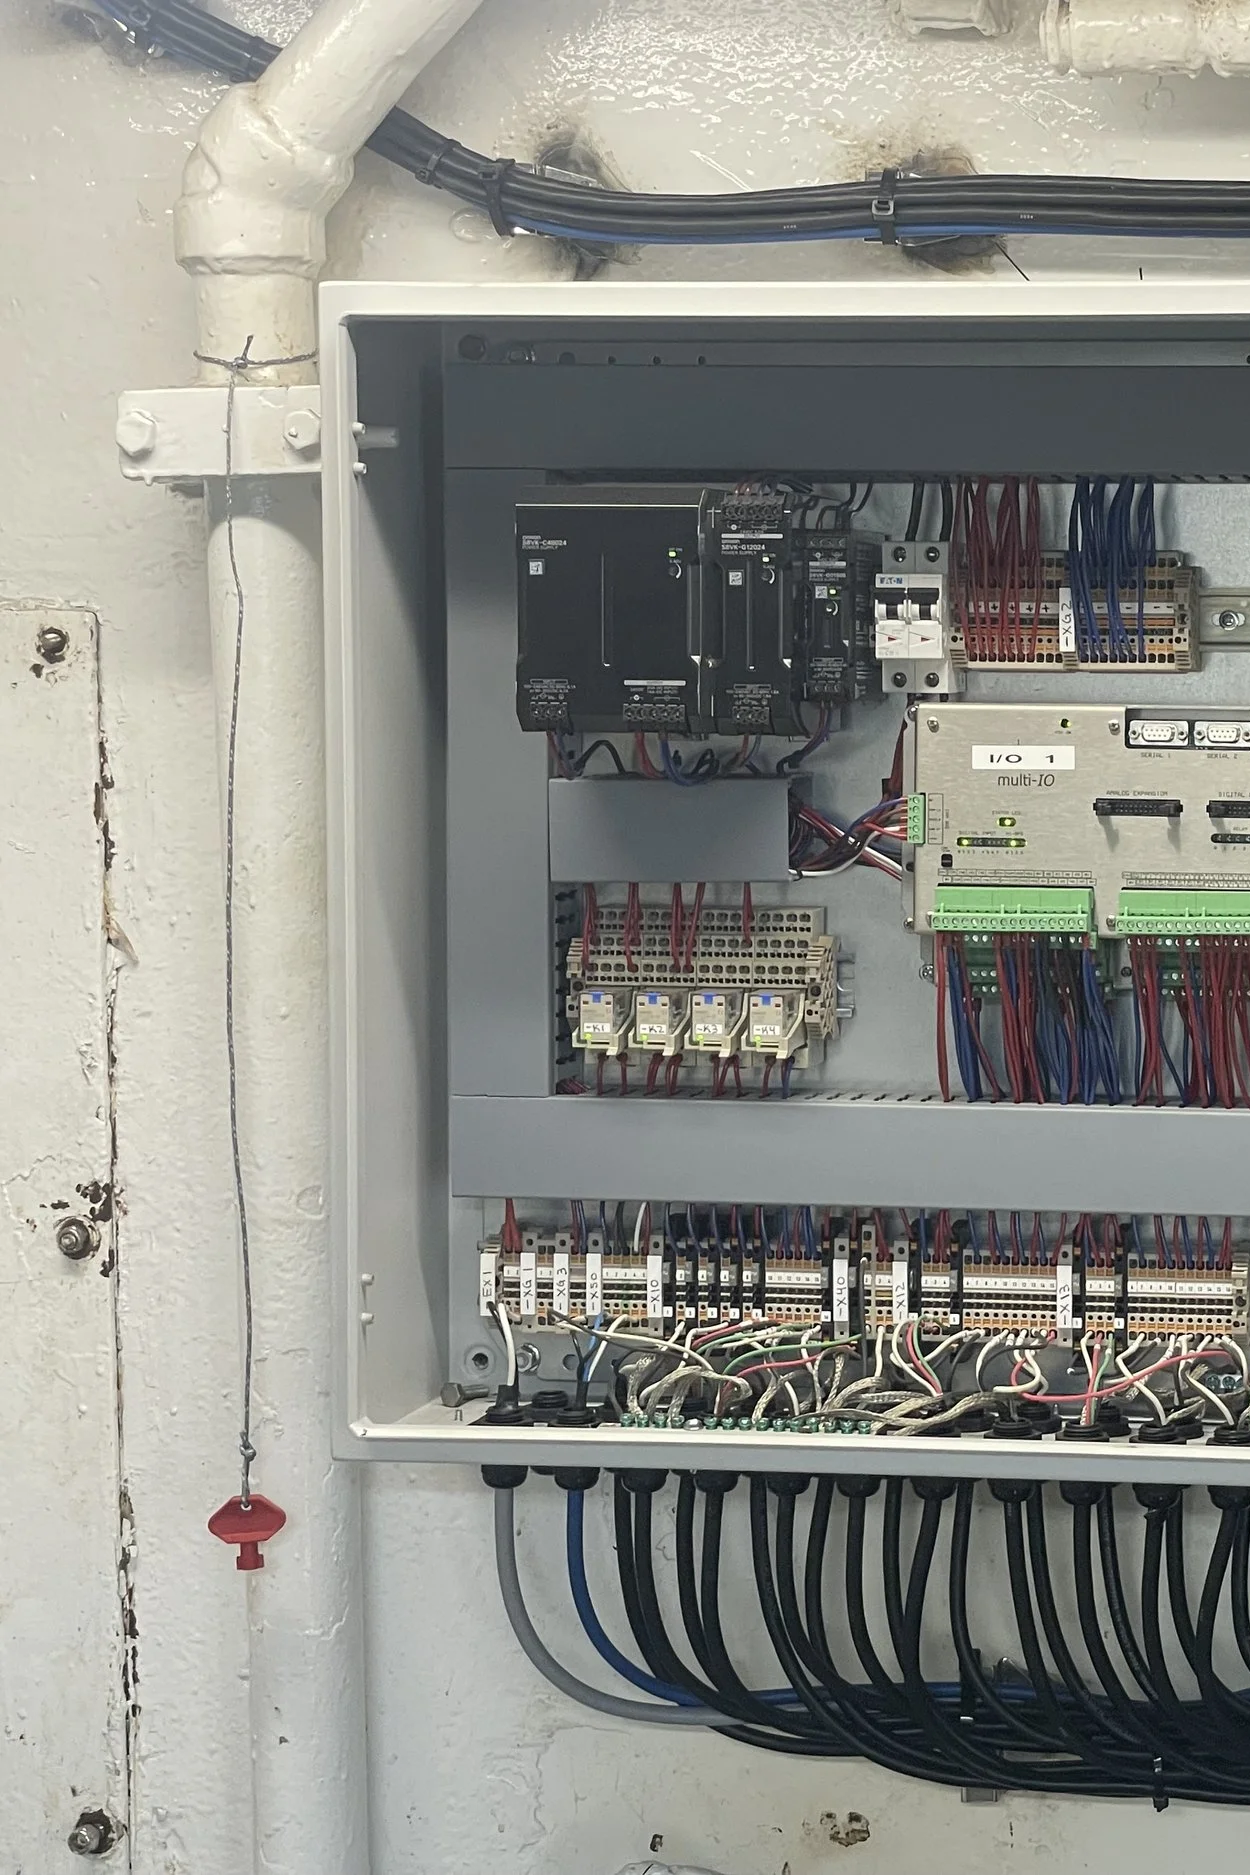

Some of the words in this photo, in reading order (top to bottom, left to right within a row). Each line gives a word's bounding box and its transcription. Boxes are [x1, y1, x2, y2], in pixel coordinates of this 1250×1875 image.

[989, 754, 1022, 764] I/O
[1045, 754, 1054, 764] 1
[1206, 752, 1231, 760] SERIAL
[997, 773, 1056, 787] multi-IO
[1218, 791, 1246, 799] DIGITAL
[585, 1024, 605, 1032] -K1
[641, 1025, 665, 1034] -K2
[697, 1024, 718, 1034] -K3
[650, 1279, 661, 1313] -X10
[1059, 1283, 1072, 1326] -X13
